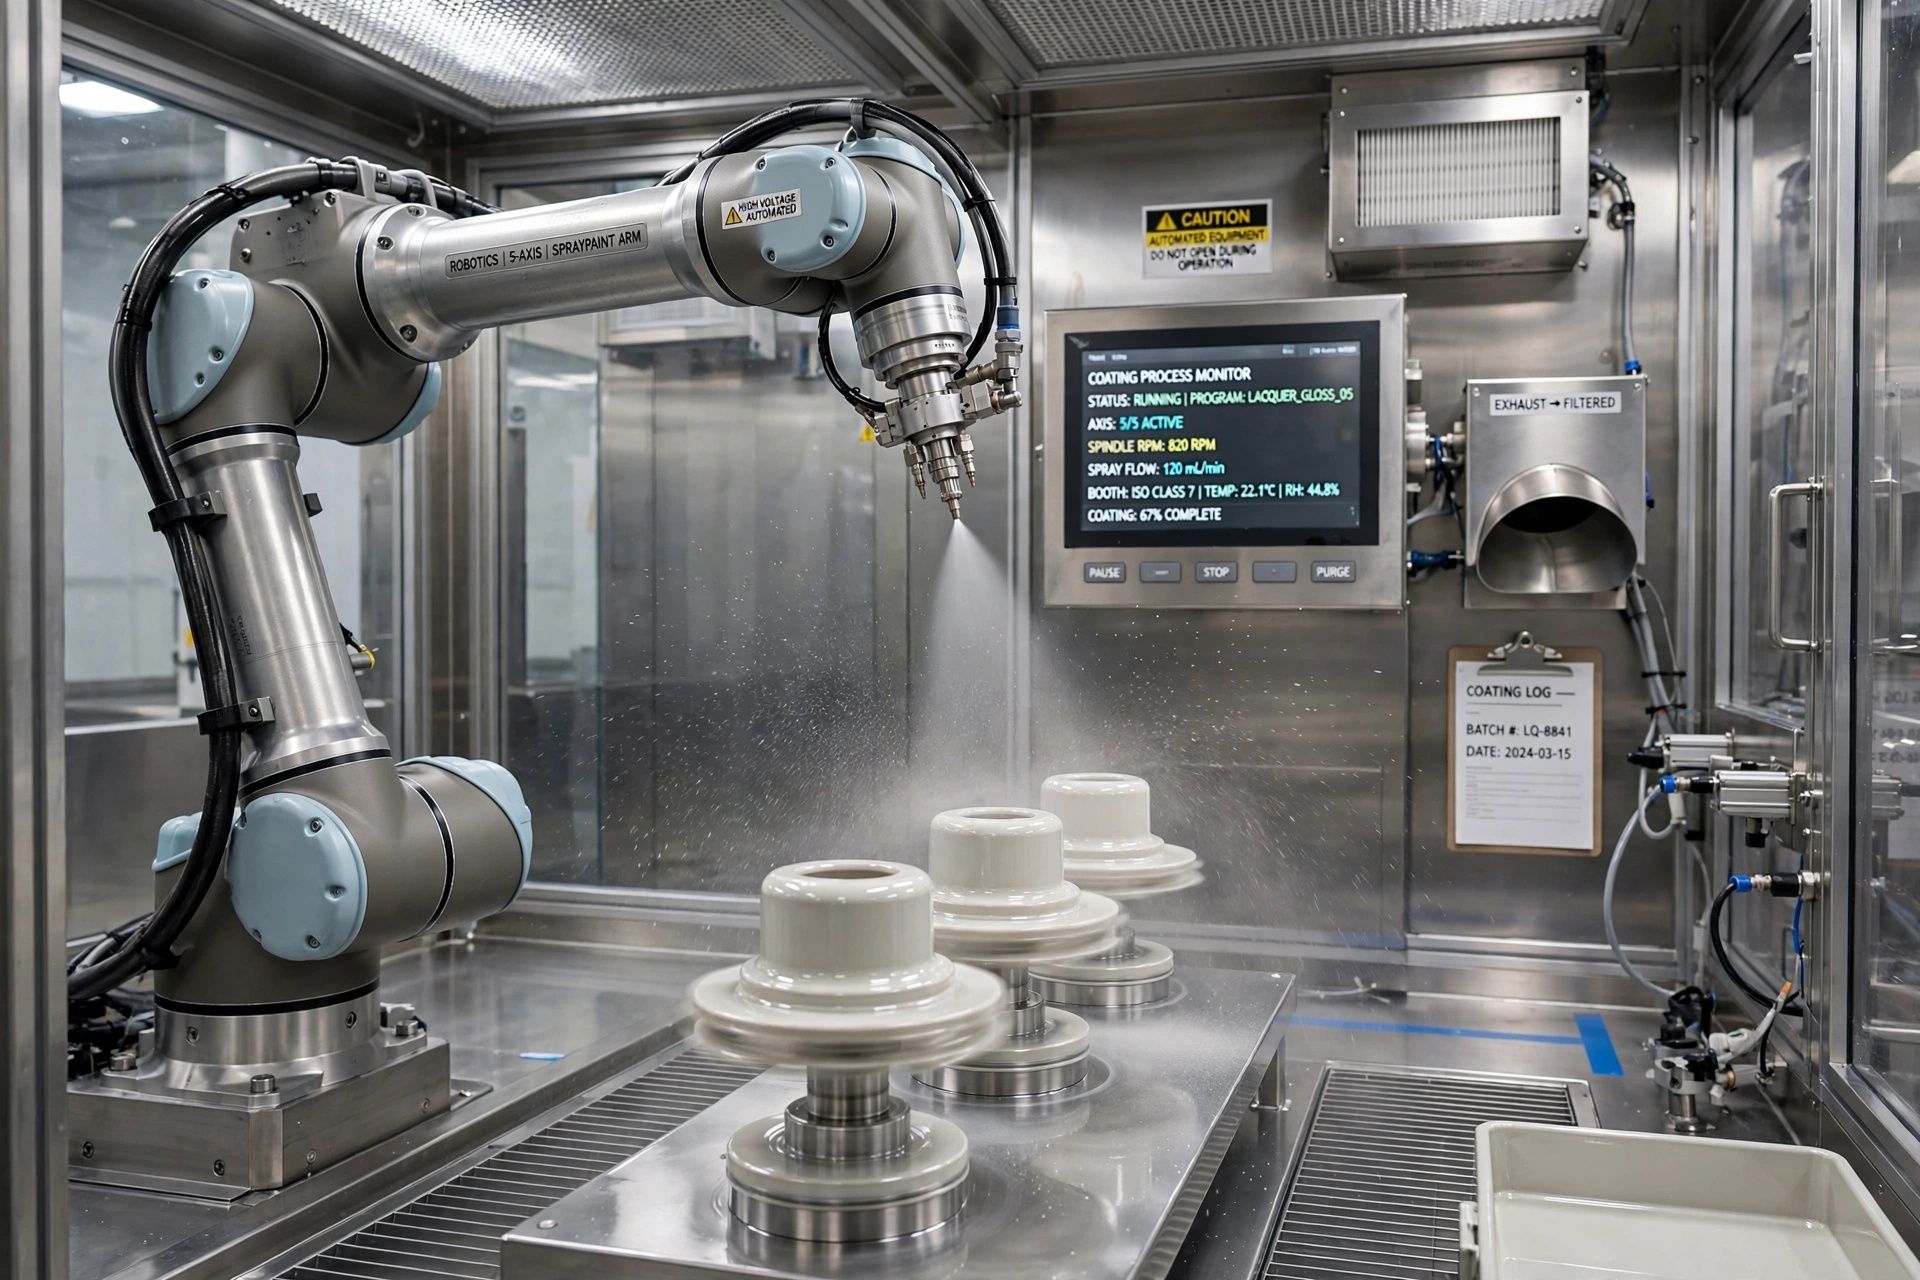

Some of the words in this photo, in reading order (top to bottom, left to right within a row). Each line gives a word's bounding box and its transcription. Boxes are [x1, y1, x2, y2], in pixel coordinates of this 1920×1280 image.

[746, 203, 797, 222] AUTOMATED
[1182, 209, 1250, 226] CAUTION
[1149, 232, 1207, 247] AUTOMATED
[450, 253, 499, 273] ROBOTICS
[509, 246, 543, 263] 5-AXIS
[552, 233, 616, 257] SPRAYPAINT
[618, 230, 642, 247] ARM
[1150, 250, 1164, 261] DO
[1167, 248, 1187, 260] NOT
[1190, 246, 1216, 258] OPEN
[1219, 244, 1257, 257] DURING
[1178, 258, 1234, 271] OPERATION
[1087, 370, 1138, 386] COATING
[1140, 368, 1193, 384] PROCESS
[1195, 367, 1252, 383] MONITOR
[1087, 394, 1131, 408] STATUS:
[1133, 392, 1182, 407] RUNNING
[1190, 391, 1246, 406] PROGRAM:
[1248, 387, 1354, 404] LACQUER_GLOSS_05
[1495, 398, 1547, 410] EXHAUST
[1563, 396, 1616, 409] FILTERED
[1087, 417, 1117, 431] AXIS:
[1119, 416, 1139, 431] 5/5
[1141, 415, 1184, 430] ACTIVE
[1087, 439, 1135, 454] SPINDLE
[1137, 439, 1166, 453] RPM:
[1167, 438, 1189, 452] 820
[1191, 438, 1216, 451] RPM
[1087, 462, 1123, 477] SPRAY
[1125, 462, 1160, 476] FLOW:
[1163, 461, 1183, 476] 120
[1185, 461, 1225, 475] mL/min
[1087, 486, 1129, 500] BOOTH:
[1131, 485, 1150, 499] ISO
[1152, 485, 1185, 499] CLASS
[1188, 485, 1195, 498] 7
[1204, 484, 1239, 498] TEMP:
[1285, 483, 1305, 497] RH:
[1307, 483, 1340, 497] 44.8%
[1087, 508, 1137, 522] COATING:
[1139, 508, 1163, 522] 67%
[1164, 507, 1222, 521] COMPLETE
[1088, 567, 1120, 579] PAUSE
[1203, 567, 1230, 578] STOP
[1316, 566, 1350, 579] PURGE
[1466, 685, 1522, 698] COATING
[1526, 686, 1551, 698] LOG
[1466, 724, 1505, 736] BATCH
[1523, 724, 1572, 738] LQ-8841
[1466, 745, 1501, 758] DATE:
[1505, 746, 1572, 760] 2024-03-15
